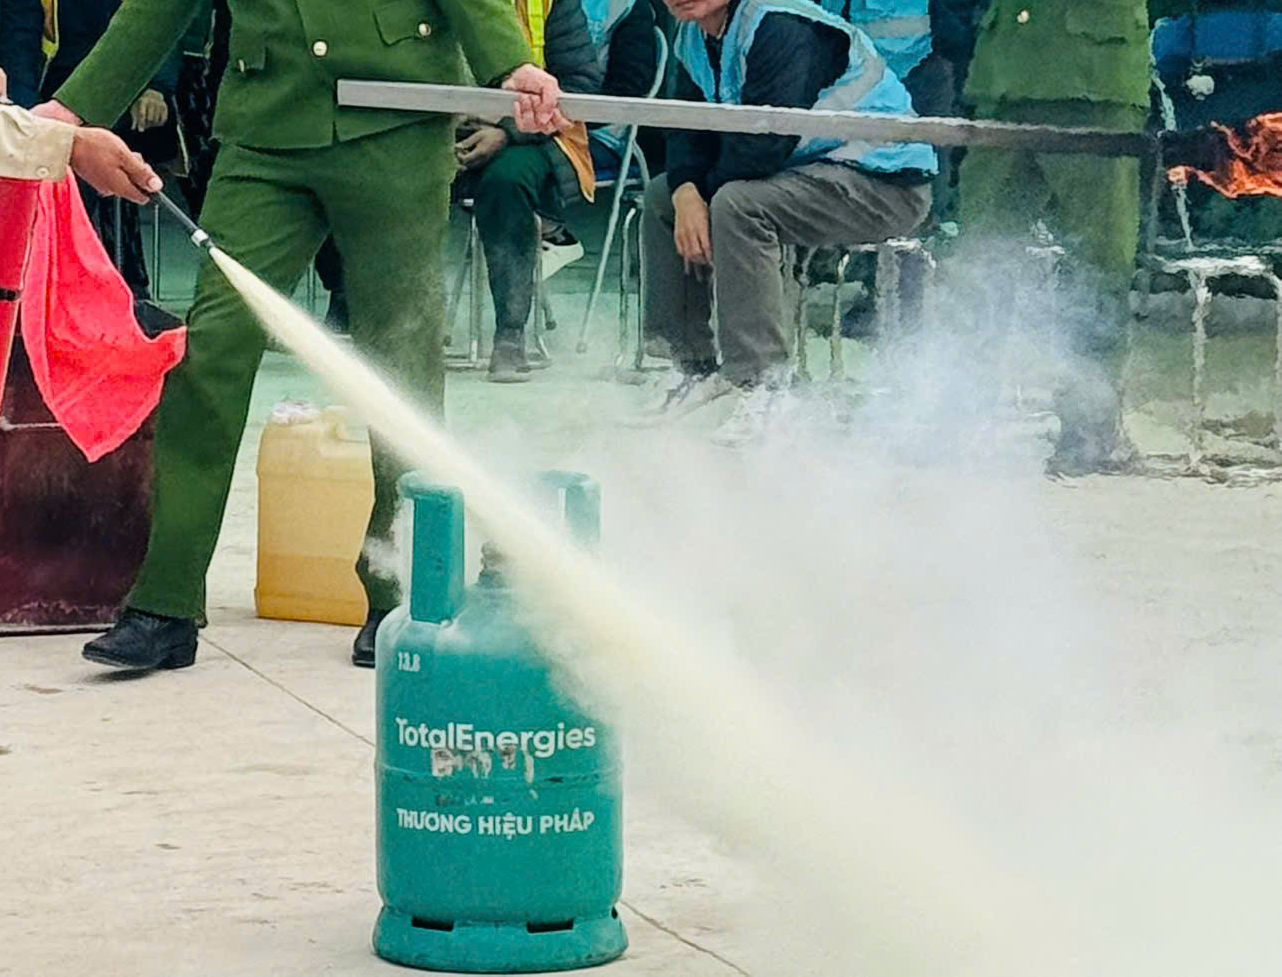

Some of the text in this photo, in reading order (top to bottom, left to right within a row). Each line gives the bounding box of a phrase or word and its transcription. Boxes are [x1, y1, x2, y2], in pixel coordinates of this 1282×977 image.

[395, 717, 596, 758] TotalEnergies
[396, 806, 595, 840] THƯƠNG HIỆU PHÁP
